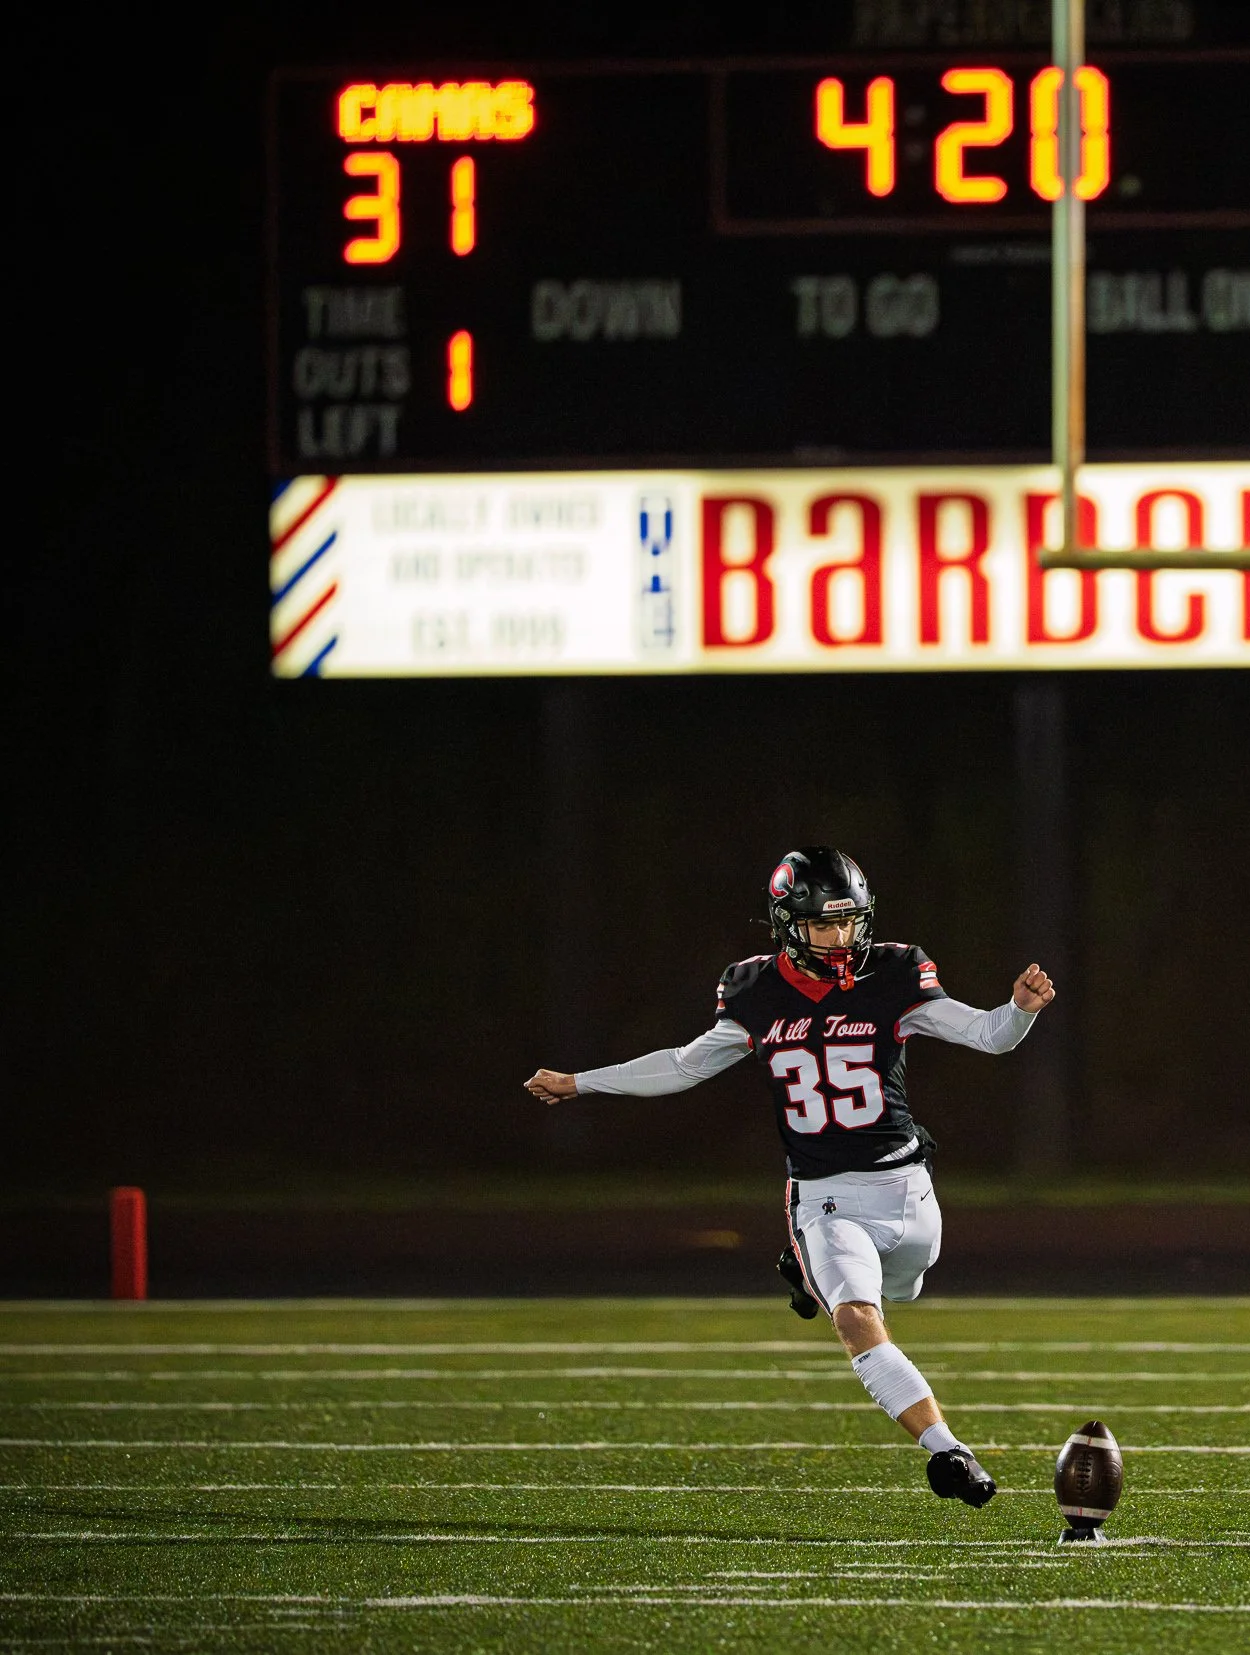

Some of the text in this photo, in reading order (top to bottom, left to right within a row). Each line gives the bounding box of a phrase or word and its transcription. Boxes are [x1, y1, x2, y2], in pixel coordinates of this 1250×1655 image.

[338, 82, 533, 142] CAMAS
[531, 279, 682, 342] DOWN
[791, 272, 940, 338] TO GO
[295, 346, 411, 400] OUTS
[448, 330, 473, 412] 1
[299, 404, 400, 457] LEFT
[760, 1013, 877, 1044] Mill Town
[768, 1043, 887, 1135] 35
